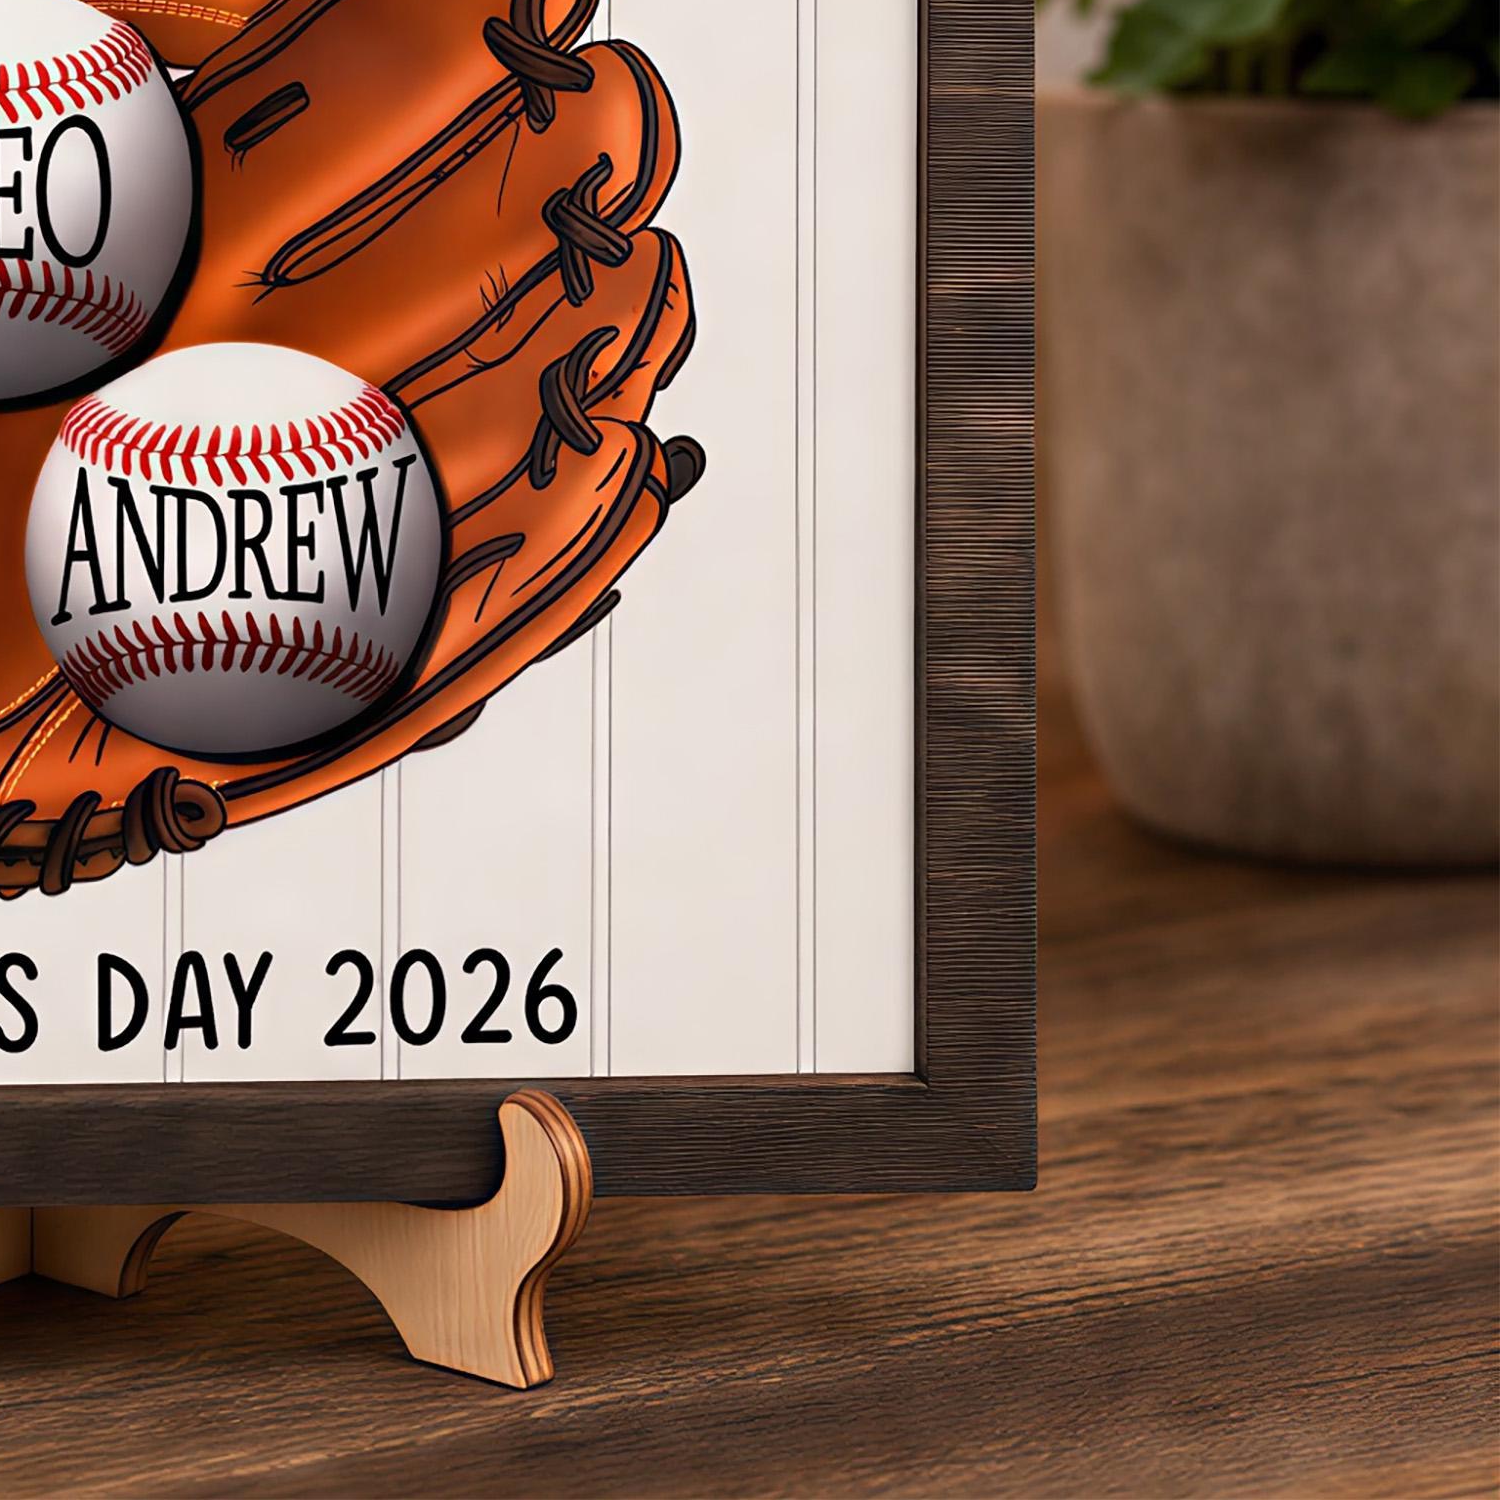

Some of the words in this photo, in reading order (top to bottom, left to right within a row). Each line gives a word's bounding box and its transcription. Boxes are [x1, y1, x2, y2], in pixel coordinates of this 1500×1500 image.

[50, 454, 419, 626] ANDREW
[97, 950, 274, 1052] DAY
[323, 947, 578, 1047] 2026
